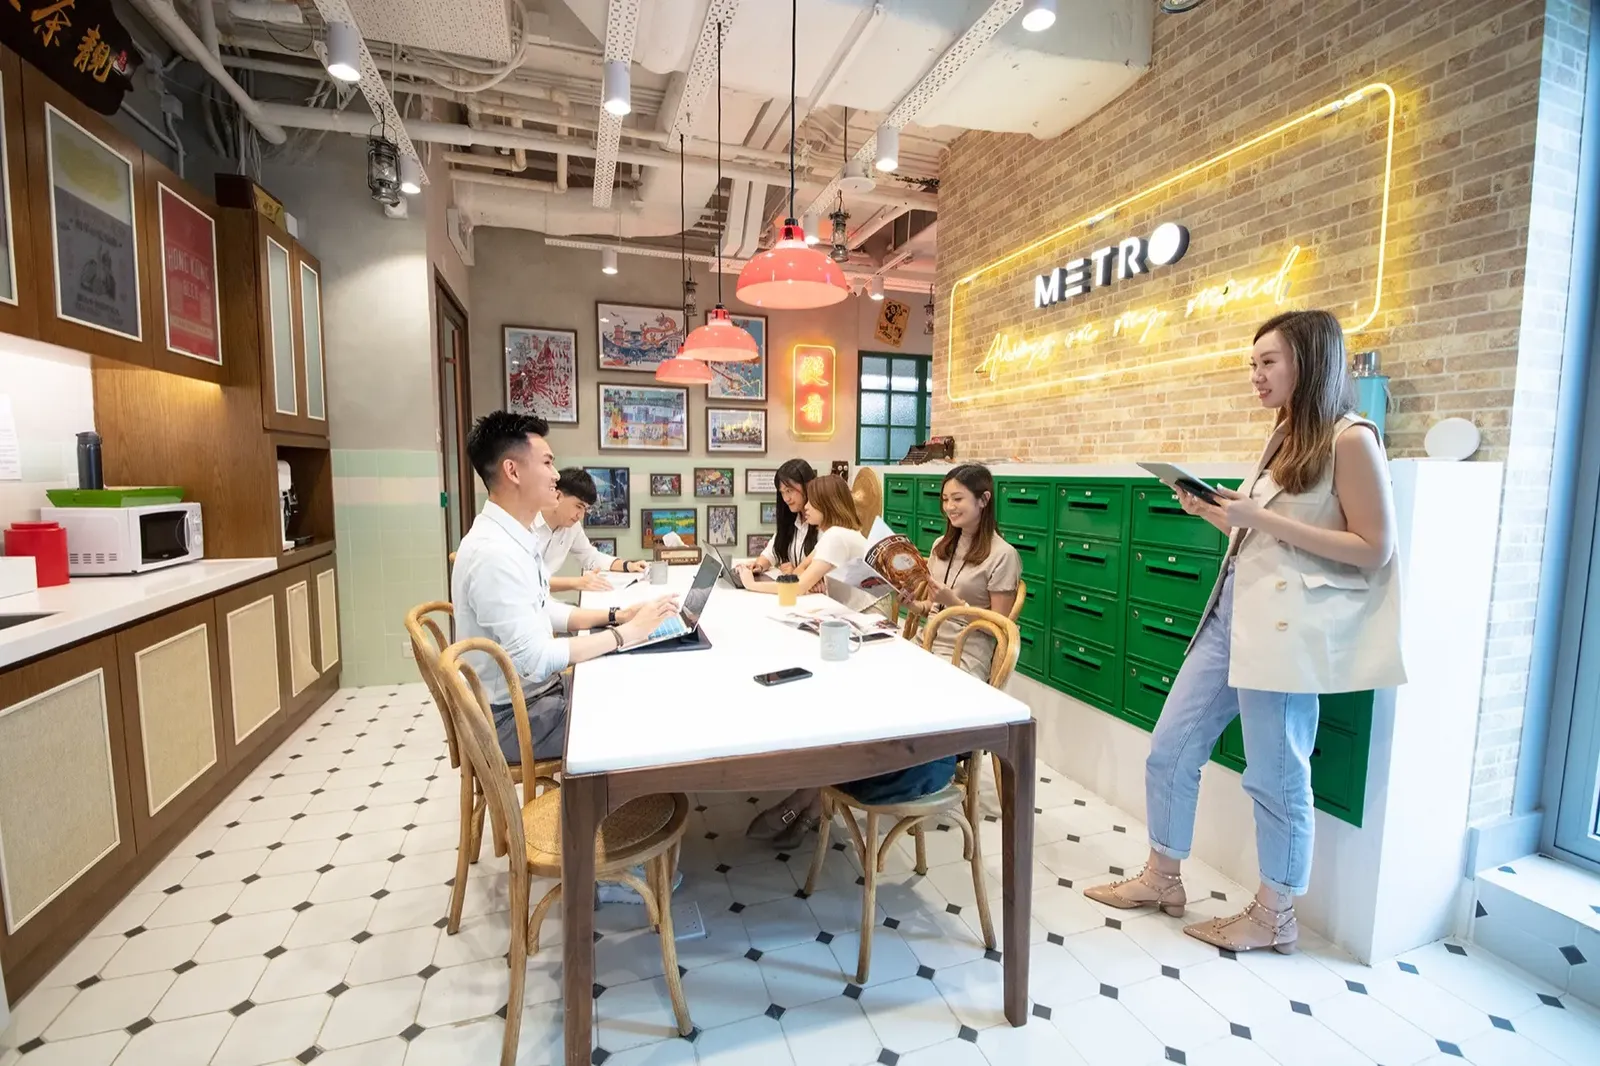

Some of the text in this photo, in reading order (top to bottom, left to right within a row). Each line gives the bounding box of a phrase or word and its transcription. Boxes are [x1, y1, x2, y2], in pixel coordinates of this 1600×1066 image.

[974, 245, 1300, 382] Always on my mind
[1034, 222, 1189, 309] METRO
